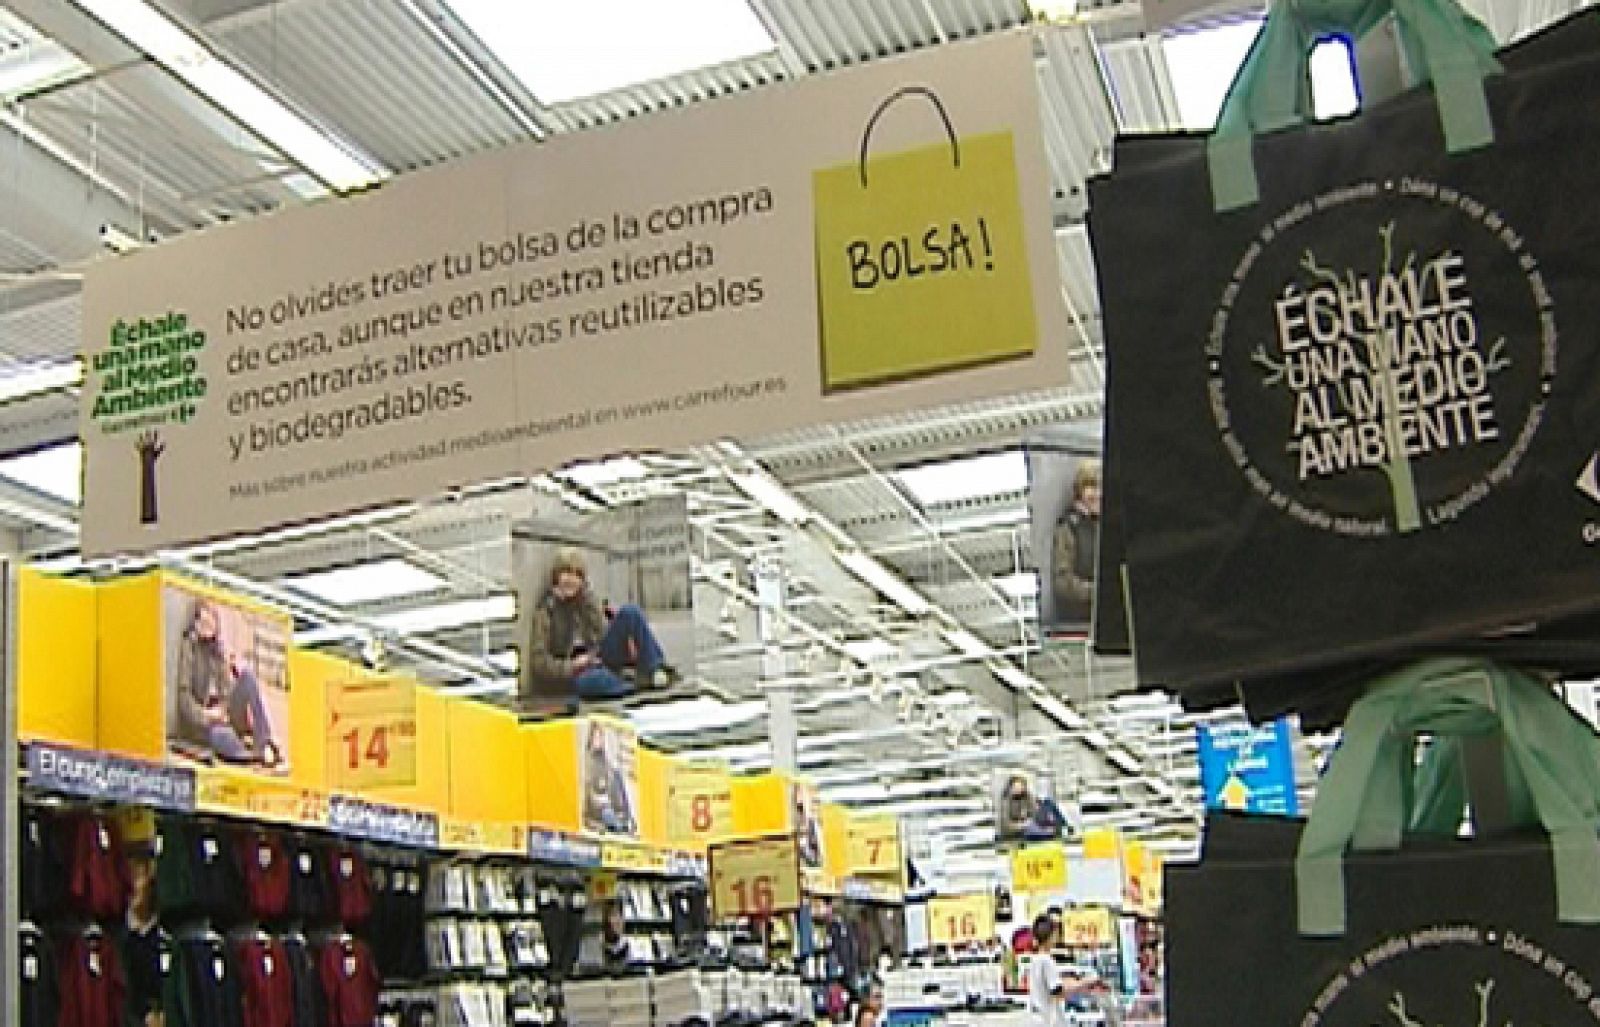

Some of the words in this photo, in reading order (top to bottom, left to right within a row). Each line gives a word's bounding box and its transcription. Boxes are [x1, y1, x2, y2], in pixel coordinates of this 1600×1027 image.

[227, 305, 265, 333] No
[270, 281, 364, 324] olvides
[371, 260, 437, 298] traer
[444, 253, 472, 279] tu
[478, 232, 559, 271] bolsa
[565, 219, 605, 252] de
[613, 213, 640, 241] la
[648, 186, 772, 234] compra
[846, 217, 994, 289] BOLSA!
[111, 312, 187, 347] Échale
[227, 350, 260, 375] de
[266, 330, 332, 364] casa,
[337, 301, 442, 347] aunque
[448, 290, 484, 321] en
[490, 266, 603, 308] nuestra
[611, 241, 714, 284] tienda
[1275, 256, 1472, 353] ÉCHALE
[93, 346, 137, 371] una
[138, 331, 205, 360] mano
[102, 369, 123, 392] al
[127, 353, 196, 388] Medio
[227, 353, 387, 415] encontrarás
[393, 317, 562, 376] alternativas
[569, 276, 763, 336] reutilizables
[1284, 339, 1365, 390] UNA
[1366, 311, 1477, 372] MANO
[91, 377, 207, 419] Ambiente
[229, 432, 245, 461] y
[250, 381, 472, 452] biodegradables.
[1295, 383, 1347, 434] AL
[1349, 351, 1487, 421] MEDIO
[264, 472, 305, 494] sobre
[310, 458, 369, 488] nuestra
[372, 441, 446, 477] actividad
[451, 409, 592, 453] medioambiental
[595, 404, 618, 423] en
[1300, 394, 1498, 480] AMBIENTE
[342, 728, 390, 769] 14
[691, 793, 713, 834] 8
[865, 838, 884, 866] 7
[729, 874, 775, 918] 16
